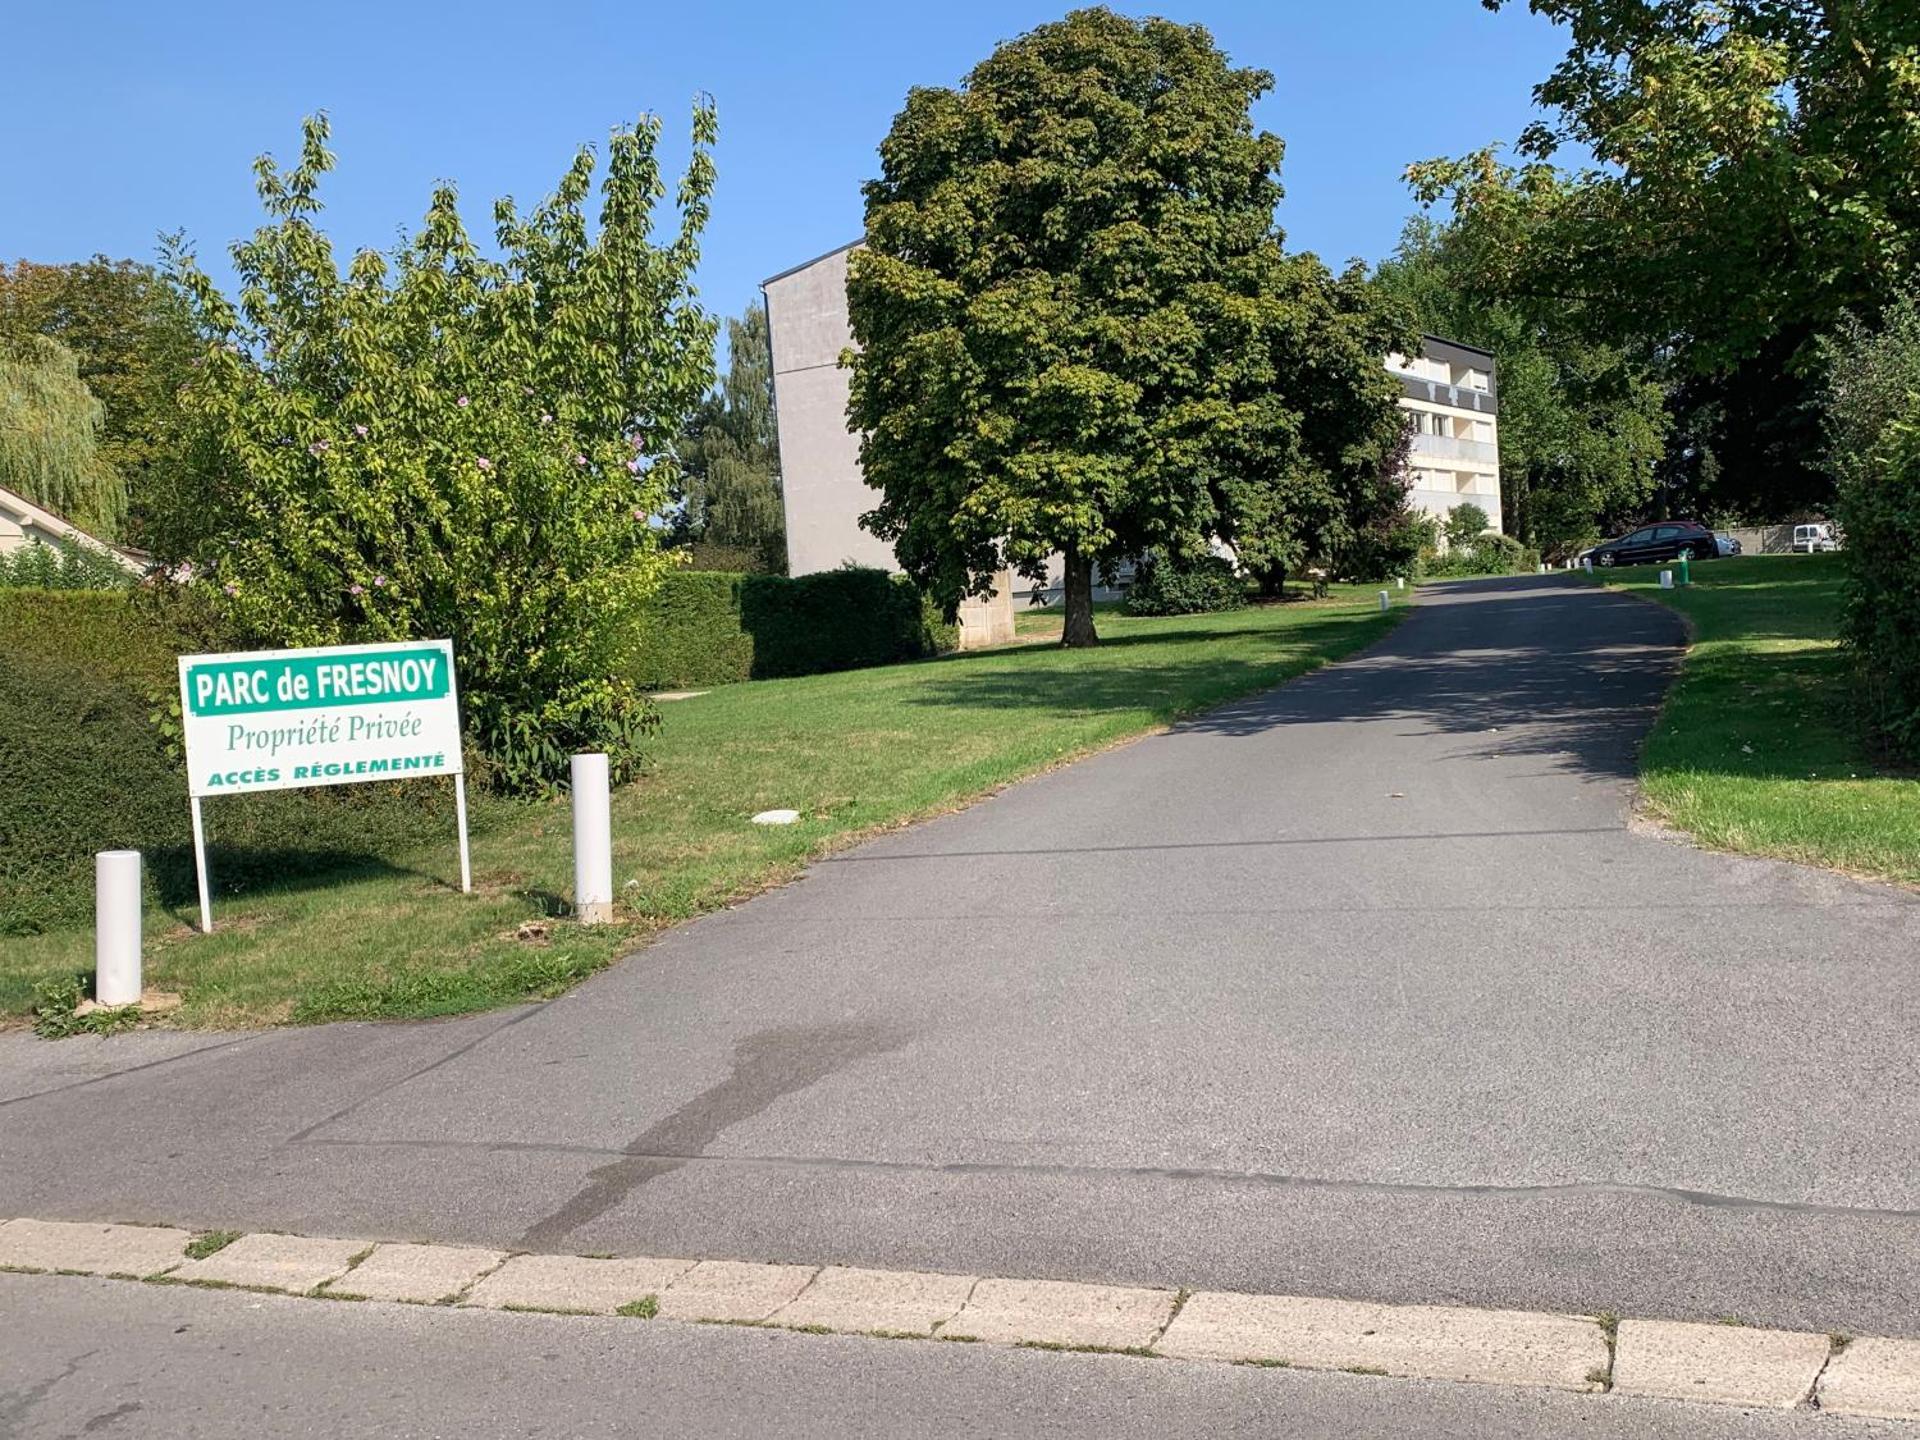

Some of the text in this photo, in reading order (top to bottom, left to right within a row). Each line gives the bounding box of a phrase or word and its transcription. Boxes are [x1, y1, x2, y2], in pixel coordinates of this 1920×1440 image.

[196, 658, 437, 707] PARC de FRESNOY
[227, 711, 422, 756] Propriété Privée
[207, 752, 445, 786] ACCÈS RÉGLEMENTÉ
